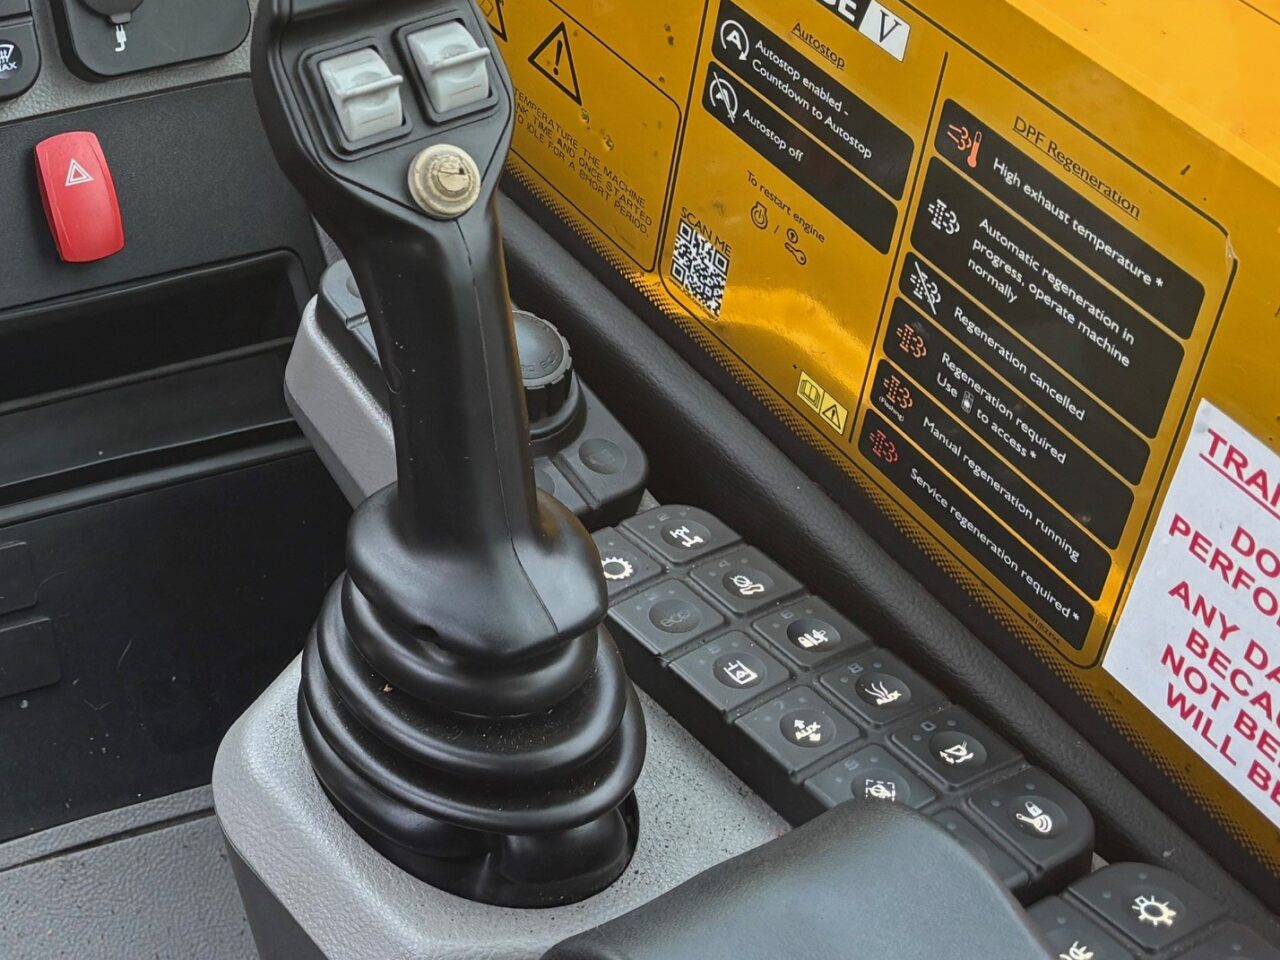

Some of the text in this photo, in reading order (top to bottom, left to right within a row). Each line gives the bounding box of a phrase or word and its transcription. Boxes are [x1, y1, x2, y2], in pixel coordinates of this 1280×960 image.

[755, 40, 800, 81] Autostop
[802, 77, 843, 112] enabled
[792, 22, 846, 70] Autostop
[878, 9, 902, 43] V
[742, 109, 804, 161] Autostop off
[752, 59, 872, 159] Countdown to Autostop
[533, 116, 553, 140] TIME
[556, 139, 576, 158] AND
[579, 157, 602, 183] ONCE
[606, 182, 653, 226] STARTED
[583, 148, 600, 166] THE
[604, 166, 646, 208] MACHINE
[747, 170, 825, 244] To restart engine
[1014, 115, 1141, 219] DPF Regeneration
[681, 206, 733, 258] SCAN ME
[993, 157, 1152, 286] High exhaust temperature
[967, 258, 1018, 304] normally
[971, 239, 1131, 368] progress, operate machine
[979, 218, 1135, 346] Automatic regeneration in
[936, 372, 1027, 458] Use to access
[941, 352, 1067, 465] Regeneration required
[954, 306, 1086, 422] Regeneration cancelled
[923, 415, 1080, 564] Manual regeneration running
[910, 467, 1071, 619] Service regeneration required
[1168, 512, 1280, 627] PERFO
[1168, 580, 1241, 642] ANY
[1160, 643, 1280, 769] NOT BE
[1166, 681, 1237, 767] WILL
[1185, 627, 1280, 731] BECA
